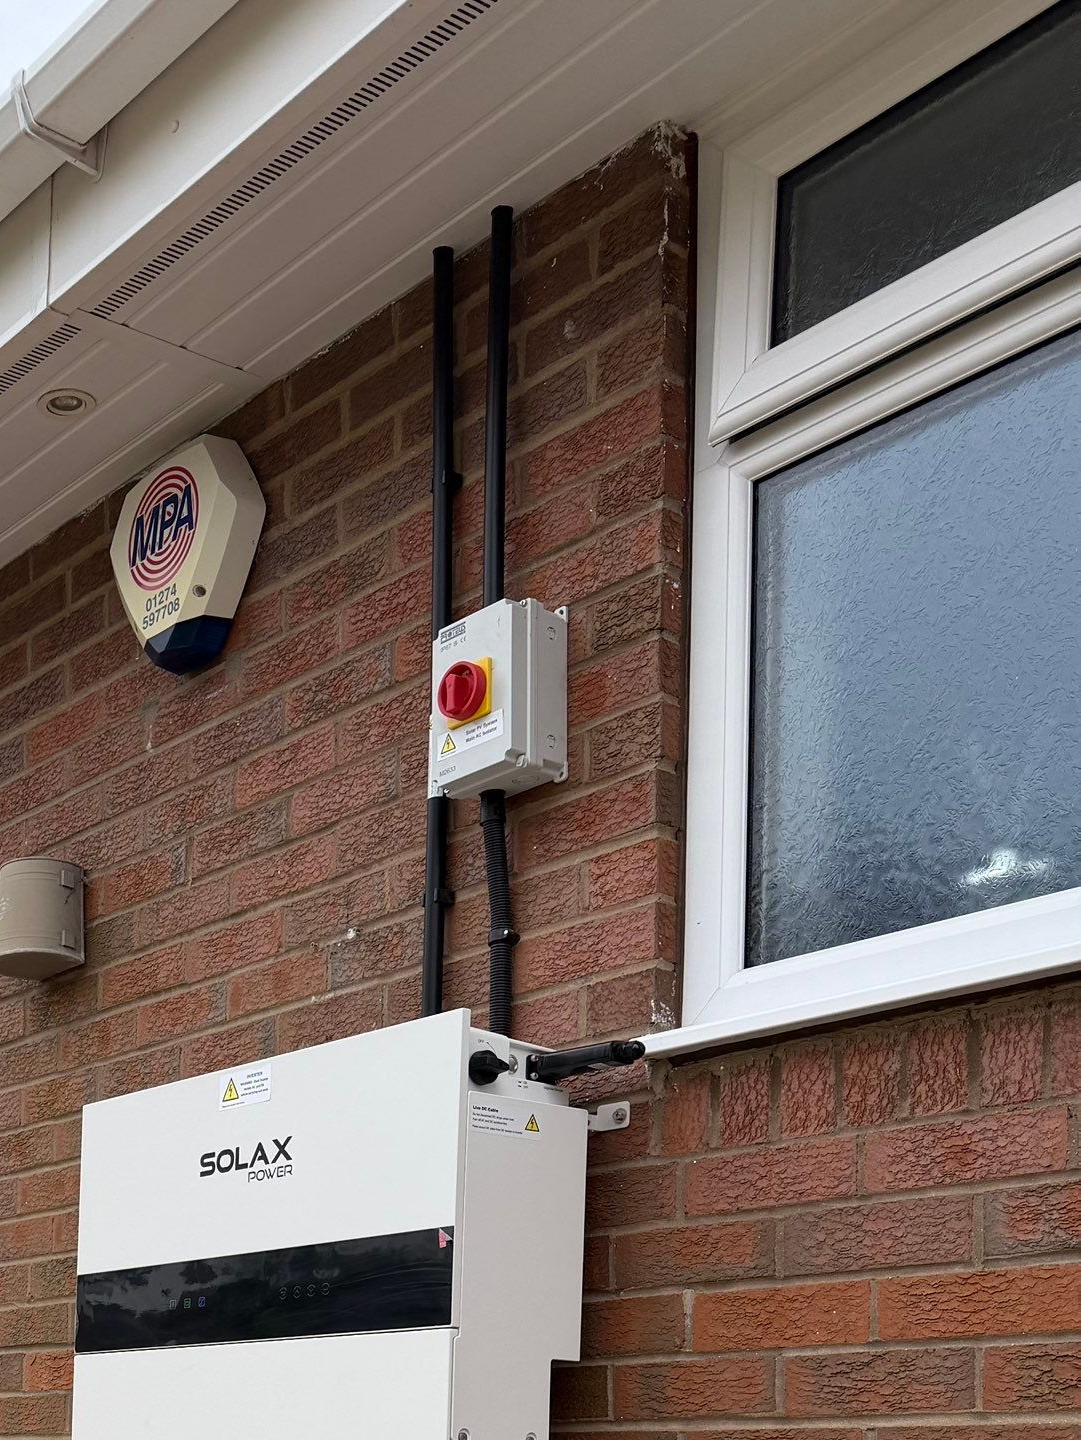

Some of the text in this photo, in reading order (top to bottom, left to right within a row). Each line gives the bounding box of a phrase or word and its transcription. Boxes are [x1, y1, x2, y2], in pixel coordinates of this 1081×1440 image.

[130, 483, 194, 568] MPA
[145, 583, 177, 612] 01274
[142, 598, 180, 630] 597708
[199, 1135, 293, 1178] SOLAX
[247, 1164, 293, 1183] POWER
